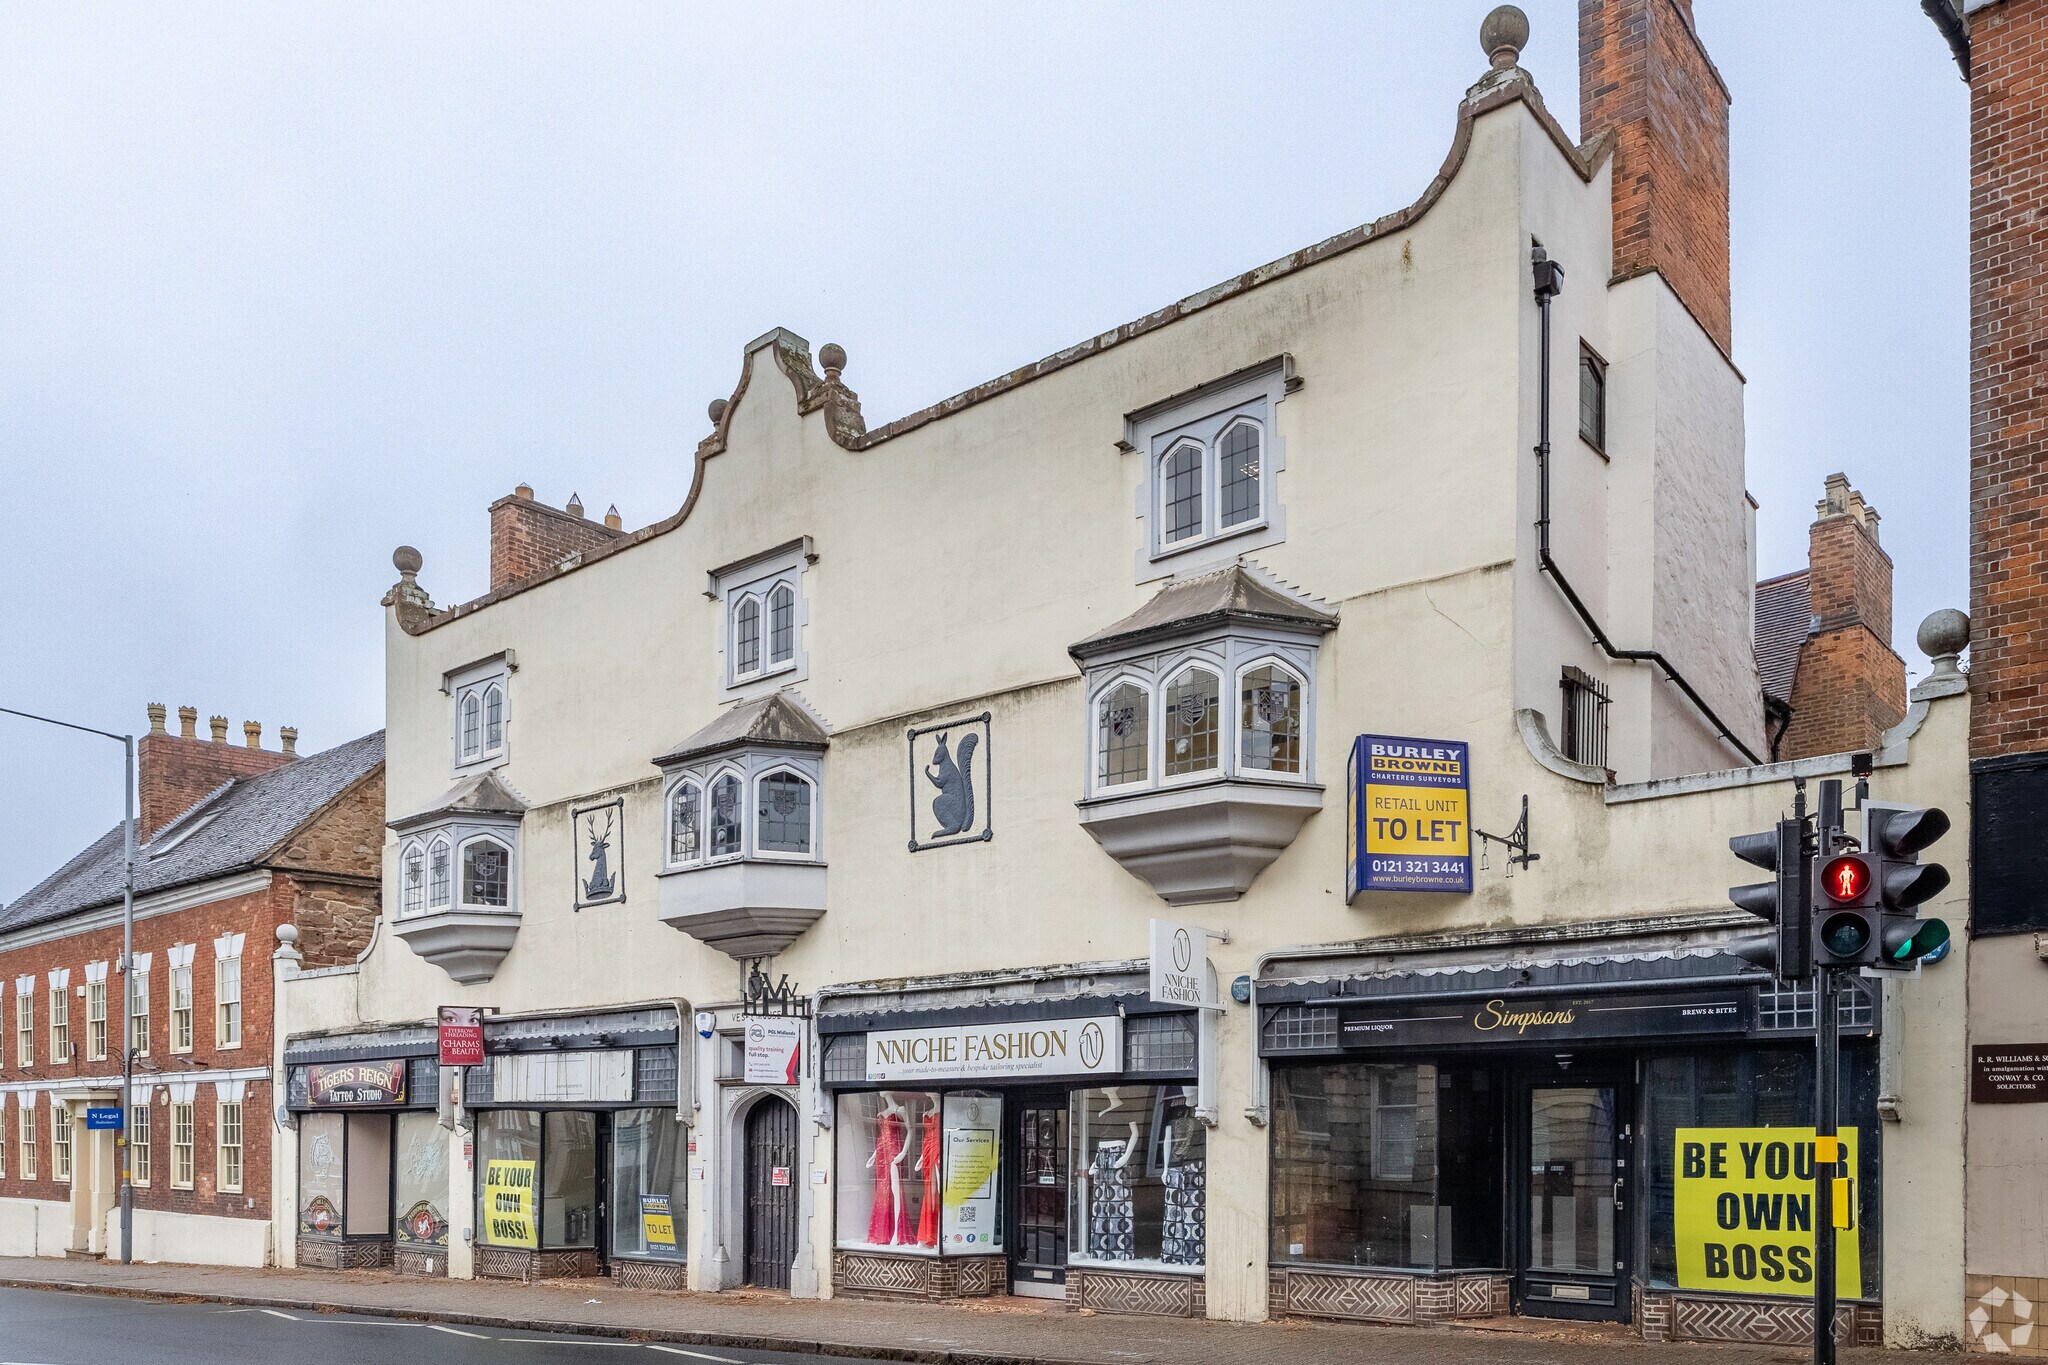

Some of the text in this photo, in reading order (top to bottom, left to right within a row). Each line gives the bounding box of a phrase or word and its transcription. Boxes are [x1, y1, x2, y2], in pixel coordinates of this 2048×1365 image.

[1371, 744, 1461, 760] BURLEY
[1373, 759, 1459, 773] BROWNE
[1371, 773, 1461, 784] CHARTERED SURVEYORS
[1375, 797, 1458, 812] RETAIL UNIT
[1373, 818, 1462, 842] TO LET
[1372, 860, 1465, 874] 0121 321 3441
[1372, 875, 1464, 885] www.burleybrowne.co.uk
[1164, 973, 1199, 991] NNICHE
[1162, 986, 1201, 1002] FASHION
[1474, 999, 1575, 1035] Simpsons
[1371, 1024, 1394, 1032] LIQUOR
[442, 1040, 480, 1048] CHARMS
[876, 1029, 1068, 1065] NNICHE FASHION
[1995, 1055, 2033, 1063] WILLIAMS
[967, 1064, 989, 1073] bespoke
[990, 1063, 1015, 1071] tailoring
[1015, 1062, 1043, 1071] specialist
[317, 1067, 393, 1092] TIGERS REIGN
[1683, 1142, 1727, 1179] BE
[487, 1167, 532, 1187] BE YOUR
[495, 1193, 521, 1213] OWN
[1716, 1192, 1811, 1232] OWN
[493, 1219, 529, 1240] BOSS!
[647, 1224, 671, 1234] TO LET
[1704, 1242, 1813, 1283] BOSS
